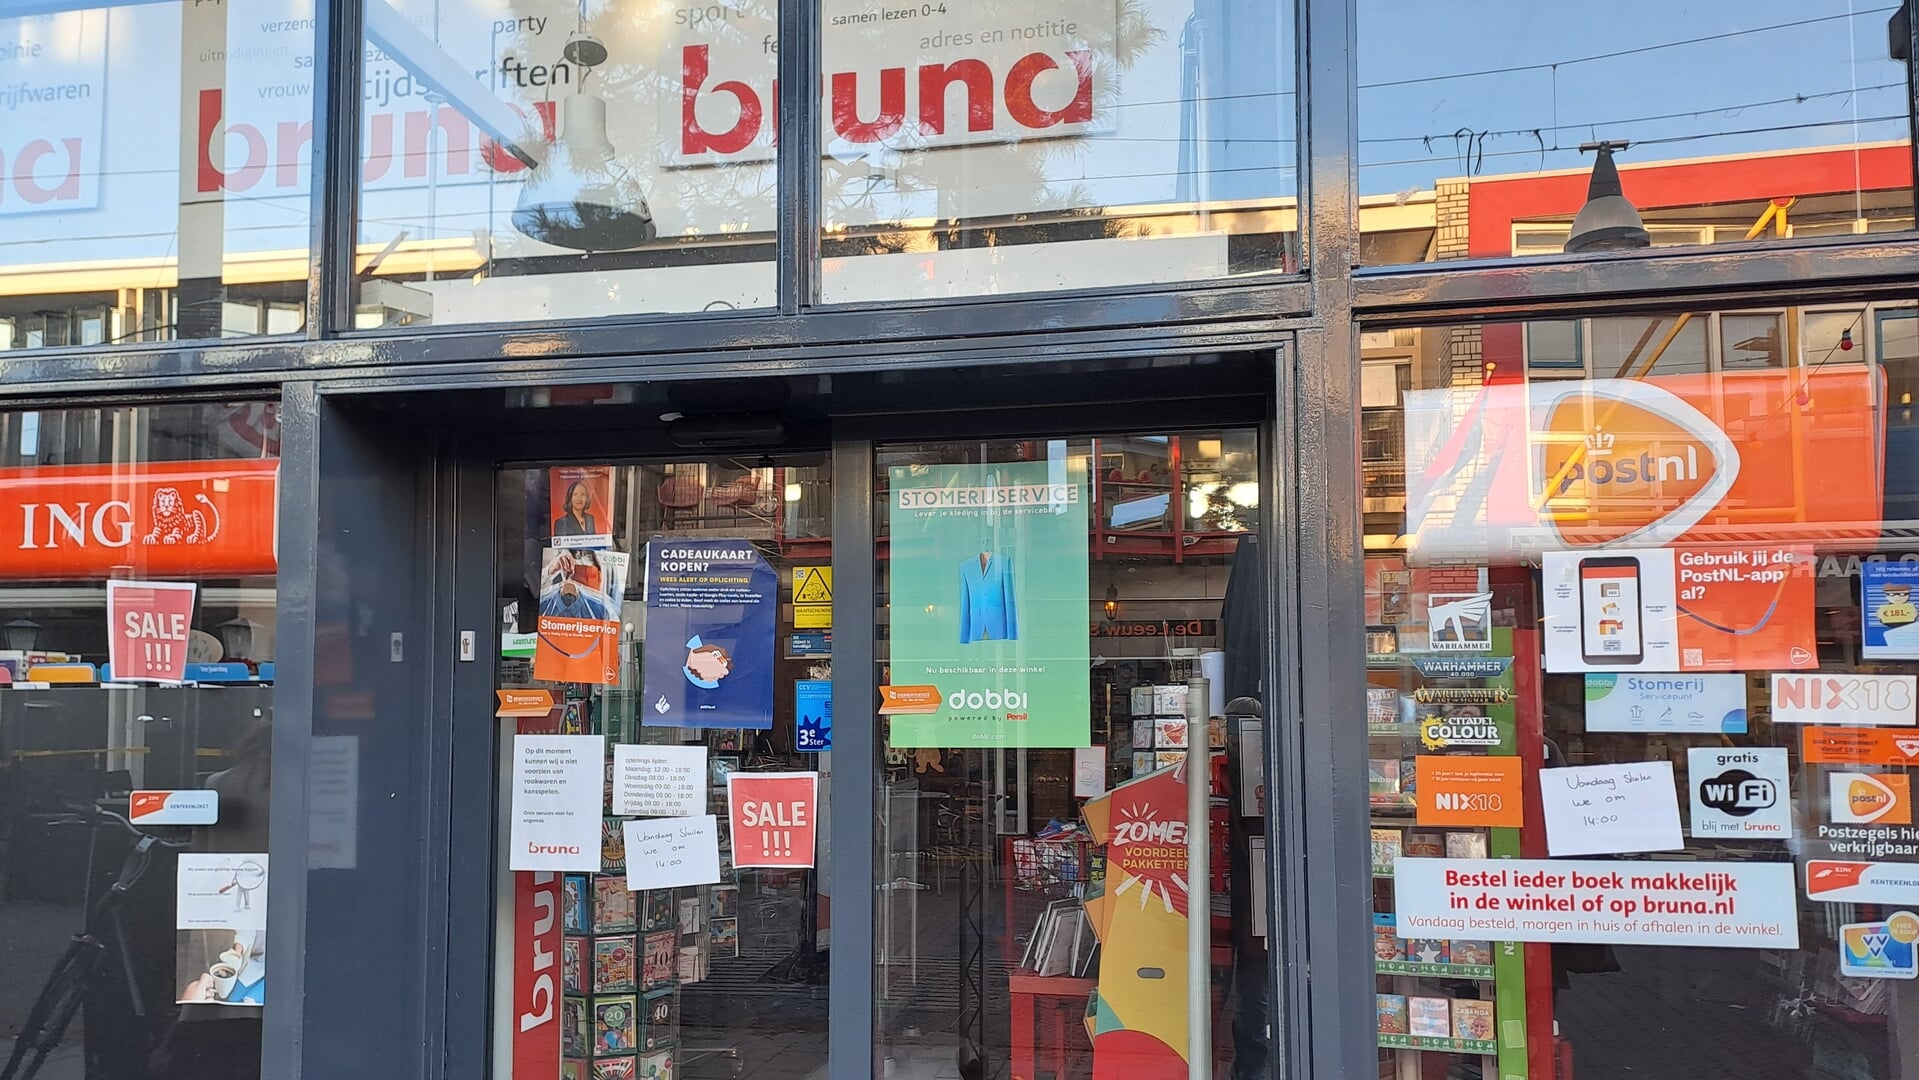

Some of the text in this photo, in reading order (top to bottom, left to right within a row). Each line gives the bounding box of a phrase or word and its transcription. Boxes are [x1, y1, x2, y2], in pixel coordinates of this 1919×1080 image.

[831, 3, 947, 26] samen lezen 0-4
[493, 15, 548, 35] party
[920, 20, 1077, 49] adres en notitie
[901, 486, 1077, 506] STOMERIJSERVICE
[18, 500, 135, 550] ING
[660, 549, 753, 560] CADEAUKAART
[1679, 549, 1794, 567] Gebruik jij de
[660, 561, 709, 572] KOPEN?
[659, 576, 749, 584] WEES ALERT OP OPLICHTING
[1680, 568, 1784, 584] PostNL-app
[1680, 585, 1706, 601] al?
[124, 610, 186, 641] SALE
[540, 618, 617, 636] Stomerijservice
[1431, 642, 1491, 650] WARHAMMER
[926, 665, 1046, 674] Nu beschikbaar in deze winkel
[1423, 661, 1501, 672] WARHAMMER
[1628, 677, 1704, 693] Stomerij
[948, 688, 1028, 710] dobbi
[1639, 692, 1693, 701] Servicepunt
[1777, 677, 1912, 712] NIX18
[948, 714, 989, 722] powered
[1006, 712, 1028, 721] Persil
[1448, 716, 1495, 726] CITADEL
[1427, 726, 1499, 739] COLOUR
[808, 738, 825, 746] Ster
[524, 747, 535, 755] Op
[548, 758, 559, 766] wij
[1716, 751, 1759, 766] gratis
[624, 766, 651, 774] Maandag
[624, 774, 648, 783] Dinsdag
[523, 788, 560, 796] kansspelen.
[624, 783, 654, 791] Woensdag
[623, 791, 655, 799] Donderdag
[1604, 794, 1626, 803] om
[1851, 794, 1887, 804] postnl
[623, 800, 644, 808] Vrijdag
[1435, 792, 1503, 812] NIX18
[741, 801, 807, 827] SALE
[1583, 815, 1618, 827] 14:00
[1701, 819, 1782, 833] blij met bruna
[1818, 825, 1898, 842] Postzegels
[528, 841, 580, 855] bruna
[671, 844, 686, 852] om
[1829, 840, 1919, 857] verkrijgbaar
[655, 859, 682, 869] 14:00
[1445, 869, 1738, 897] Bestel ieder boek makkelijk
[1449, 891, 1735, 918] in de winkel of op bruna.nl
[1408, 915, 1465, 931] Vandaag
[1469, 916, 1519, 931] besteld,
[1522, 919, 1573, 934] morgen
[1577, 919, 1589, 931] in
[1593, 920, 1620, 932] huis
[1624, 919, 1638, 933] of
[1641, 920, 1694, 934] afhalen
[1698, 921, 1710, 934] in
[1714, 921, 1732, 935] de
[1735, 922, 1783, 936] winkel.
[605, 1010, 624, 1022] 20
[653, 1004, 669, 1021] 40
